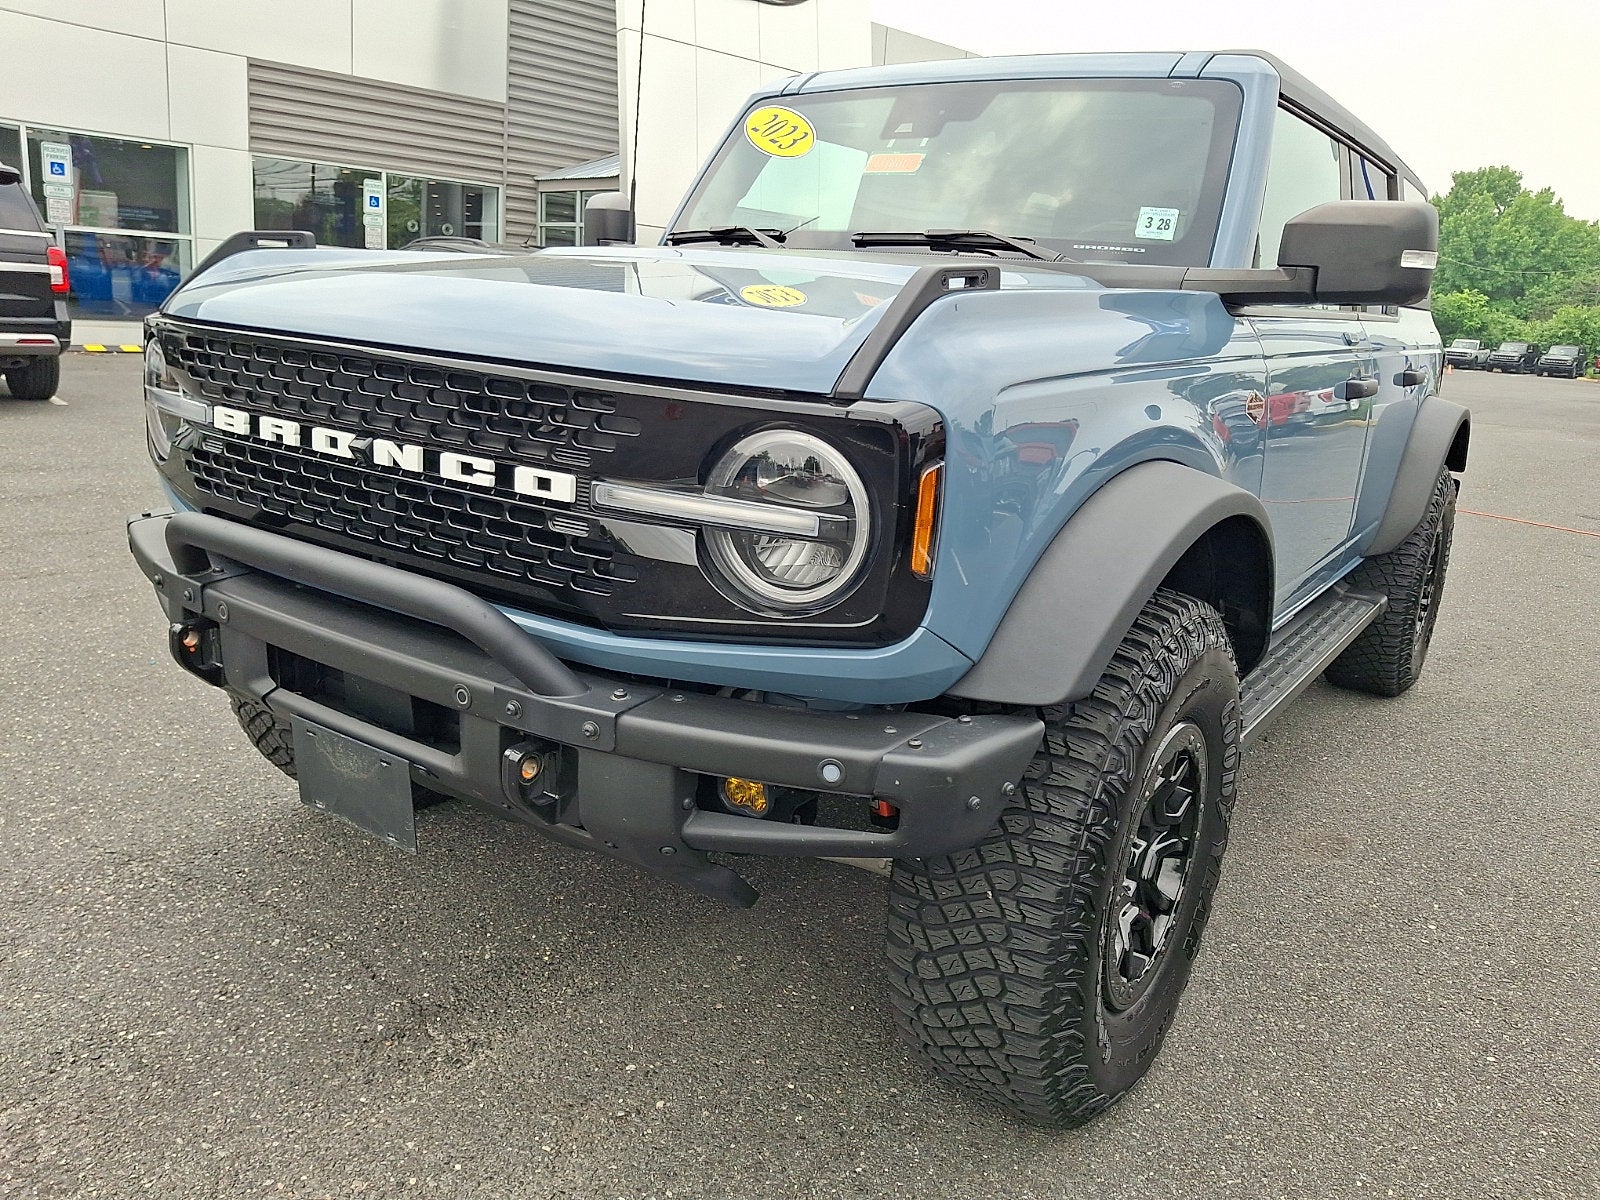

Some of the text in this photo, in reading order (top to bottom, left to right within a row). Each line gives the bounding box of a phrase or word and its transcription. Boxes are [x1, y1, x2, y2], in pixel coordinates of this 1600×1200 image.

[751, 113, 809, 150] 2023
[1145, 216, 1172, 231] 3 28
[1073, 244, 1146, 253] BRONCO
[212, 405, 578, 504] BRONCO
